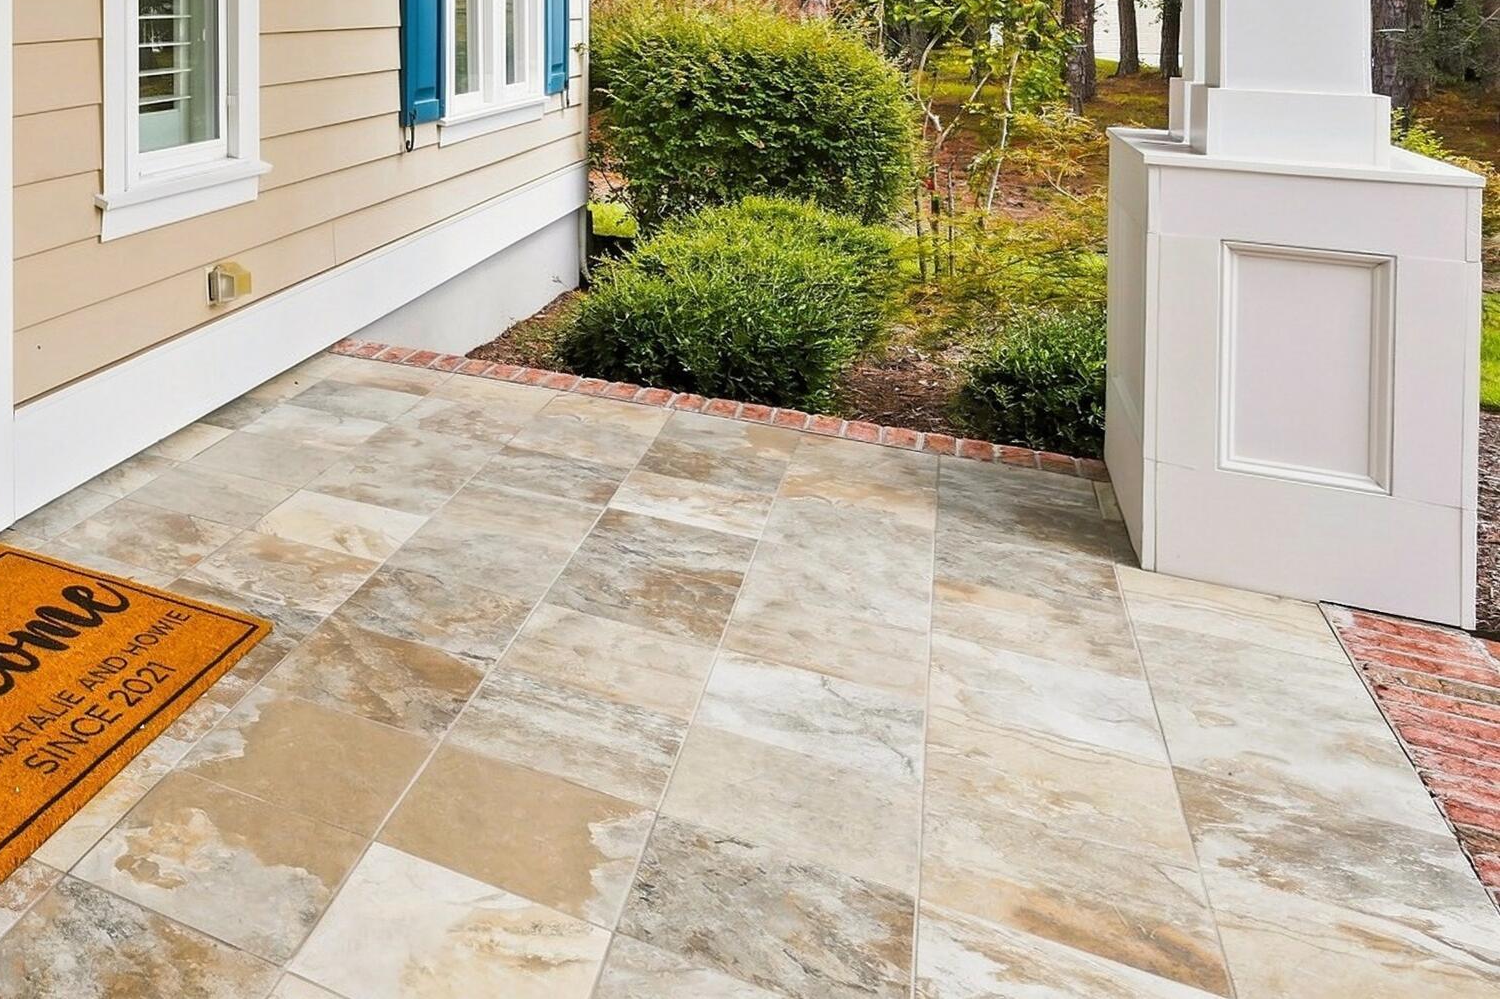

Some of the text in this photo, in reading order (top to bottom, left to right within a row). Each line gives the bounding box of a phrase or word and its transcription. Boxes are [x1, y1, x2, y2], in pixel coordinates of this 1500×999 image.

[78, 656, 128, 692] AND
[121, 610, 191, 656] HOWIE
[23, 661, 177, 775] SINCE 2021
